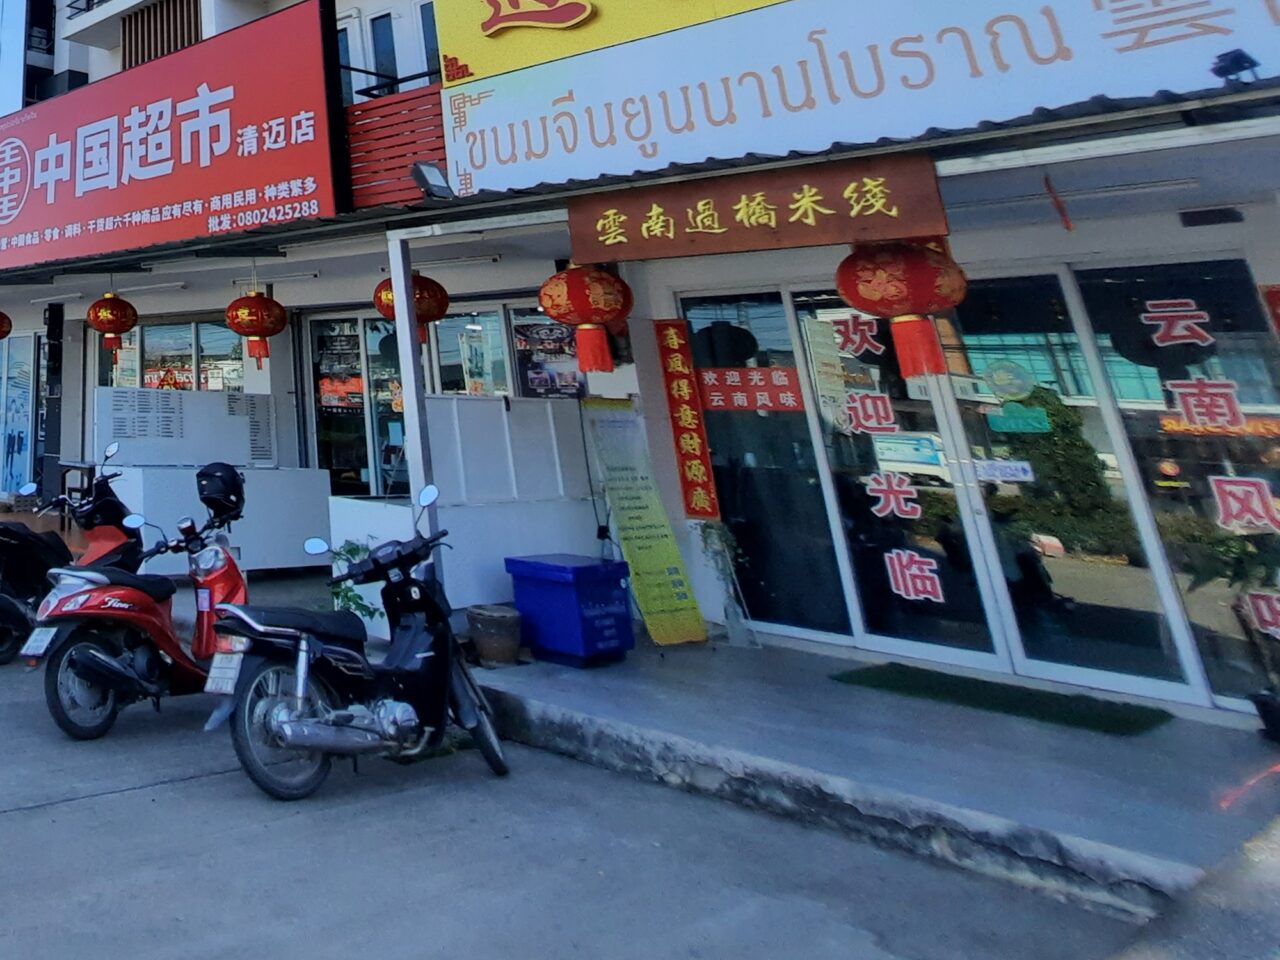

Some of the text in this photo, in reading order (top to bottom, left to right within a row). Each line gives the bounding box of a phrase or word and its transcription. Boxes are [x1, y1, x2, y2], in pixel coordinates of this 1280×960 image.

[33, 82, 316, 205] 中国超市 清迈店
[466, 5, 1074, 172] ขนมจีนยูนนานโบราณ
[701, 370, 789, 387] 欢迎光临
[832, 313, 946, 603] 欢迎光临
